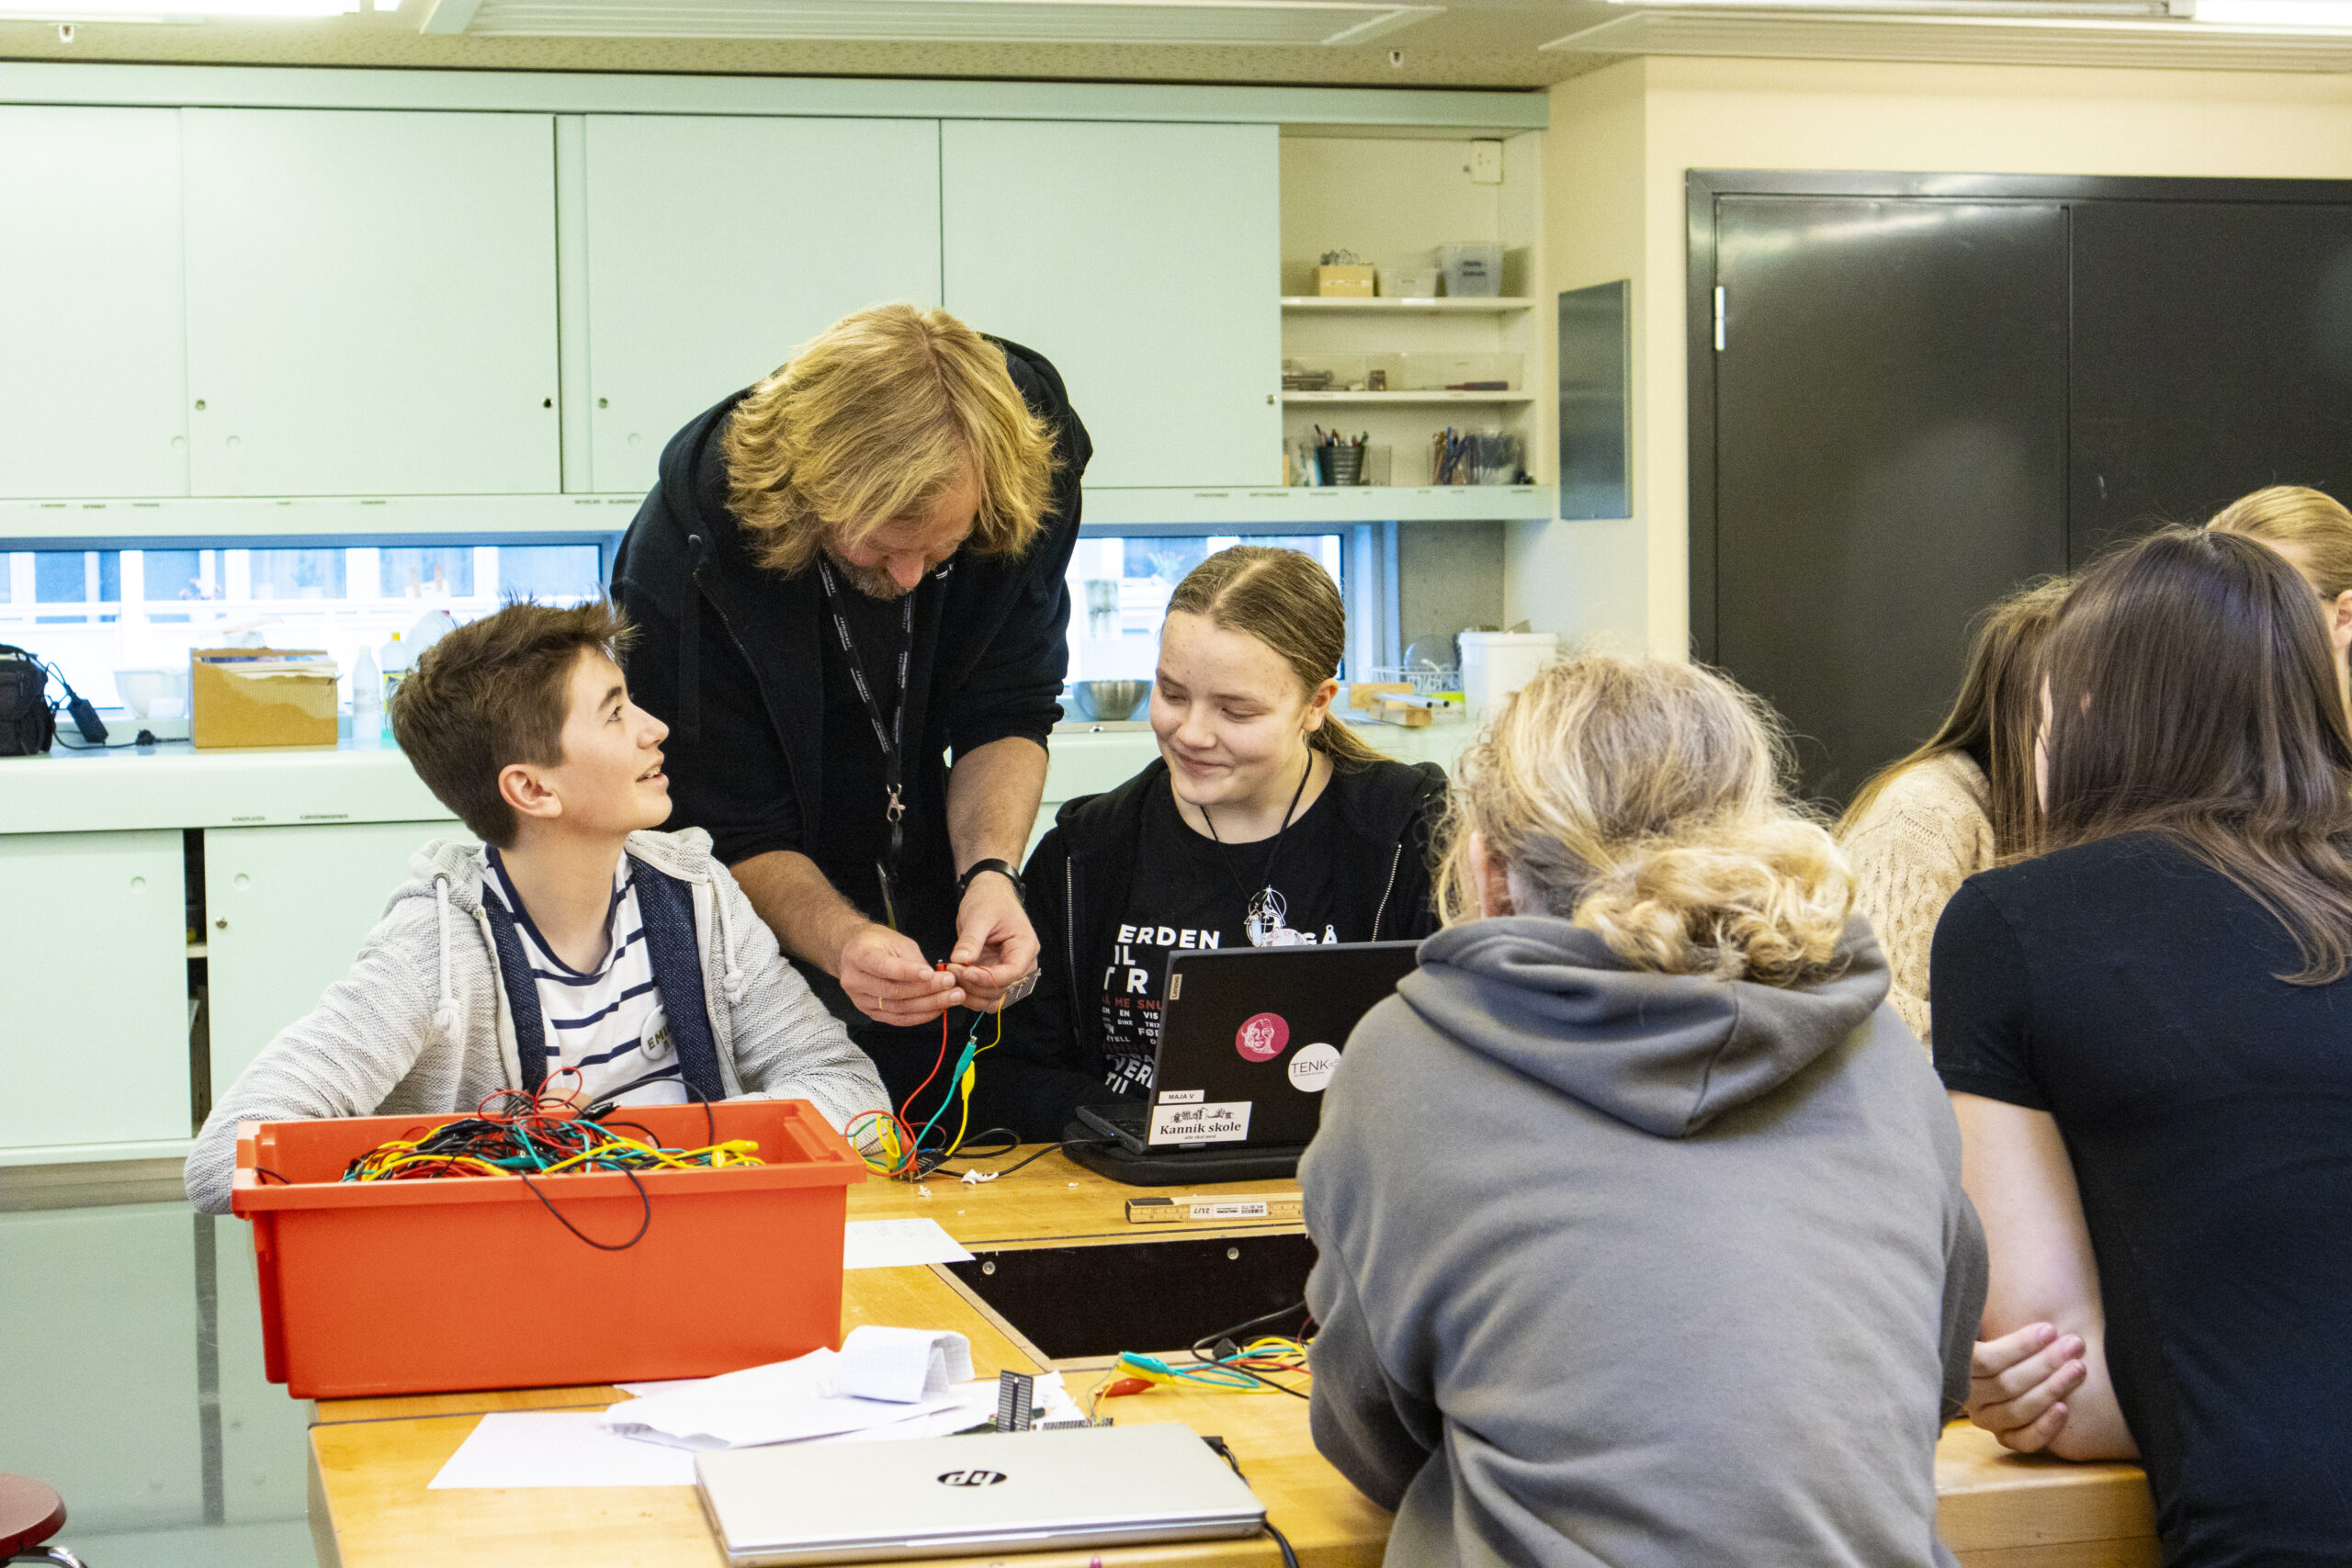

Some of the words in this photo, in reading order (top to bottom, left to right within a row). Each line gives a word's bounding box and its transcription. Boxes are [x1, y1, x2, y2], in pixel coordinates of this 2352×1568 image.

[1171, 976, 1181, 998] Lenovo
[1114, 998, 1131, 1008] ME
[1120, 1010, 1130, 1018] EN
[1143, 1011, 1159, 1020] VIS
[1160, 1123, 1206, 1134] Kannik
[1207, 1122, 1241, 1133] skole
[940, 1470, 1005, 1486] hp
